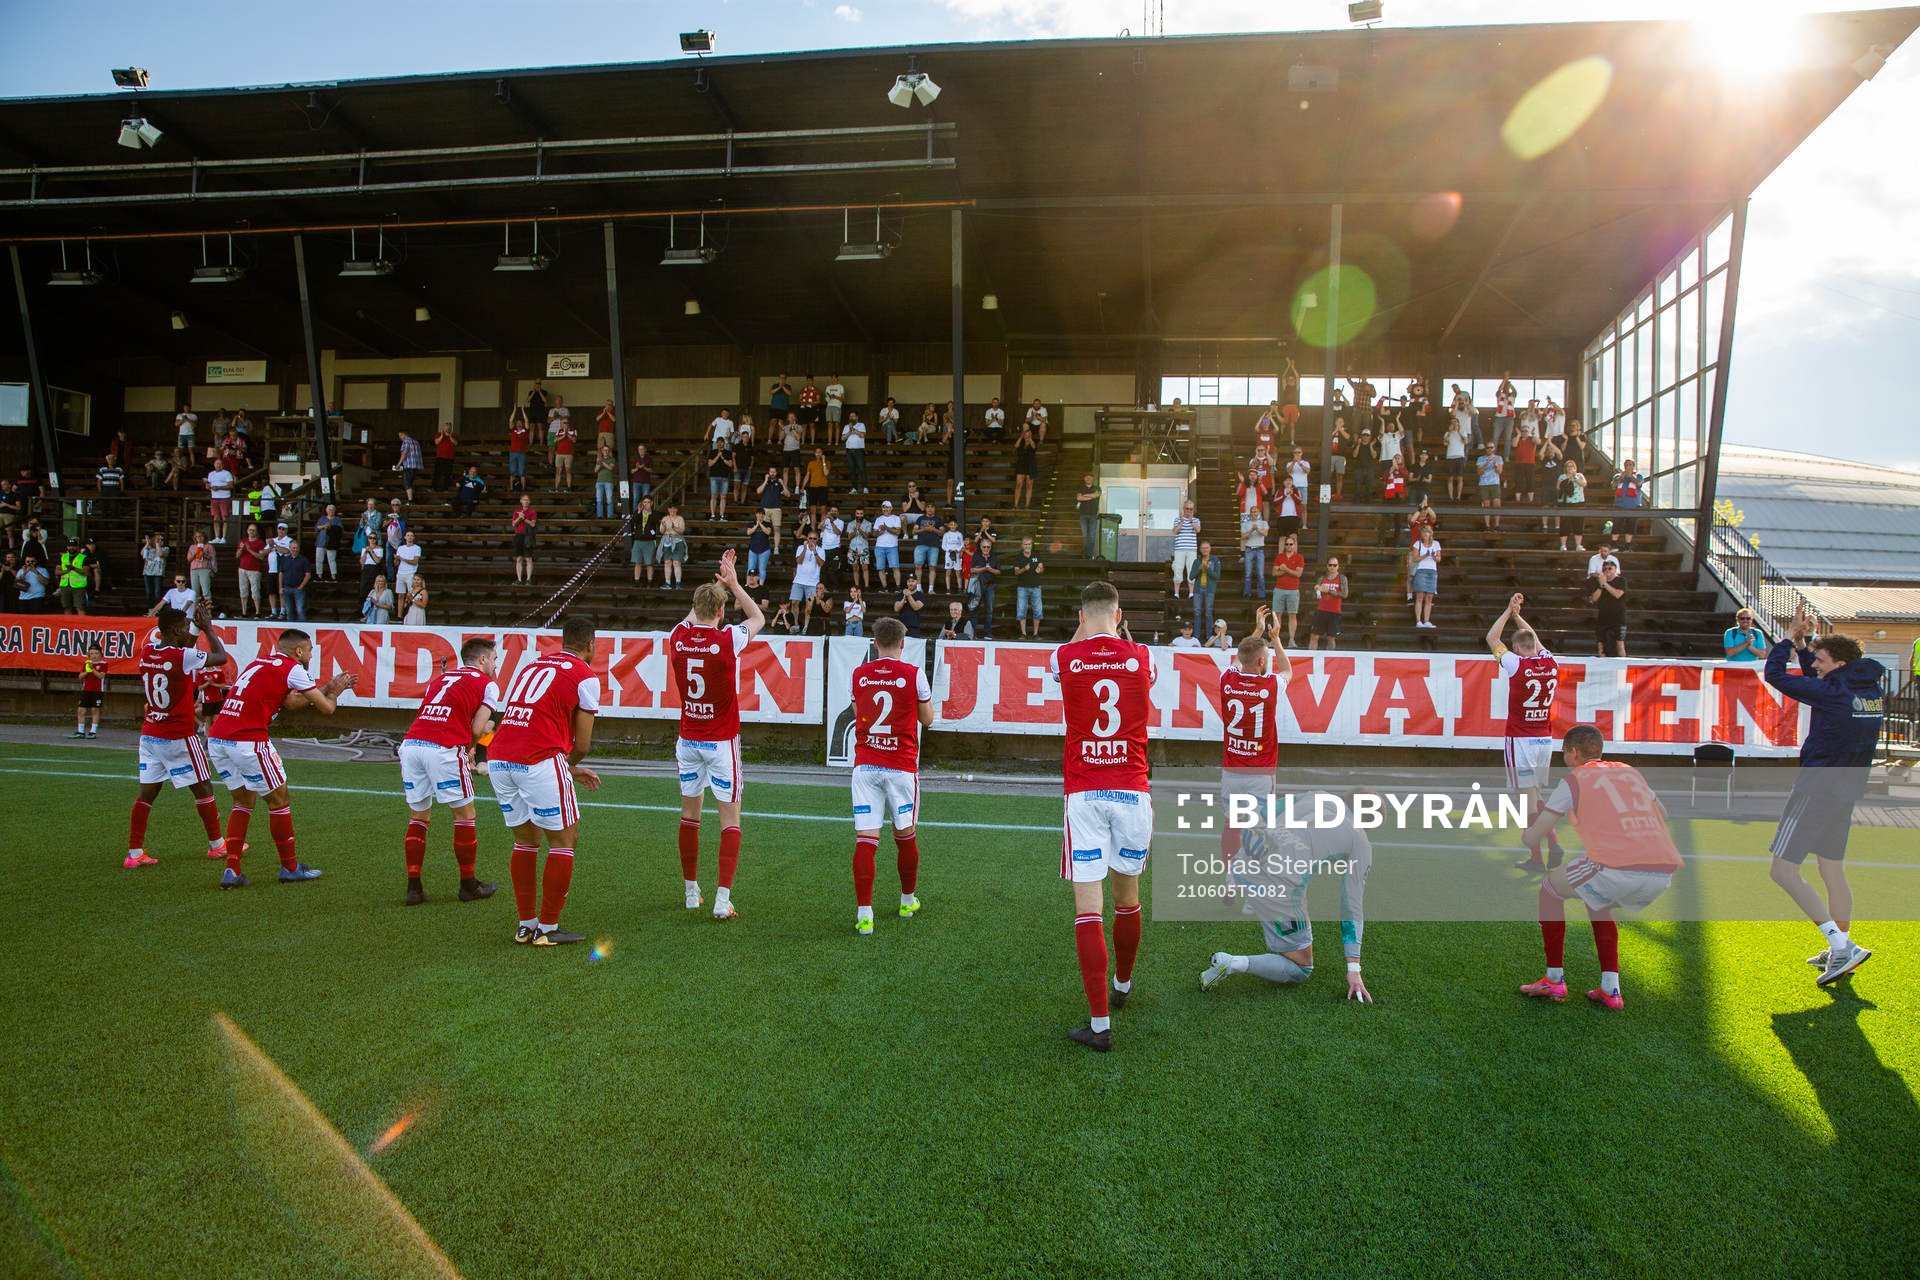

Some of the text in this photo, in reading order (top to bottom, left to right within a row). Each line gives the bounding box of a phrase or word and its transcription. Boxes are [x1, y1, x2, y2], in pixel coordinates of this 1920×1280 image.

[31, 627, 136, 658] FLANKEN
[234, 664, 264, 696] 4
[687, 658, 706, 699] 5
[1070, 659, 1125, 673] MaserFrakt
[143, 672, 170, 709] 18
[430, 675, 462, 704] 7
[509, 666, 557, 704] 10
[941, 646, 1804, 747] JENVALLEN
[1522, 678, 1558, 708] 23
[869, 690, 893, 734] 2
[1092, 679, 1121, 738] 3
[1226, 698, 1265, 739] 21
[1083, 756, 1128, 765] clockwork
[1592, 772, 1652, 814] 13
